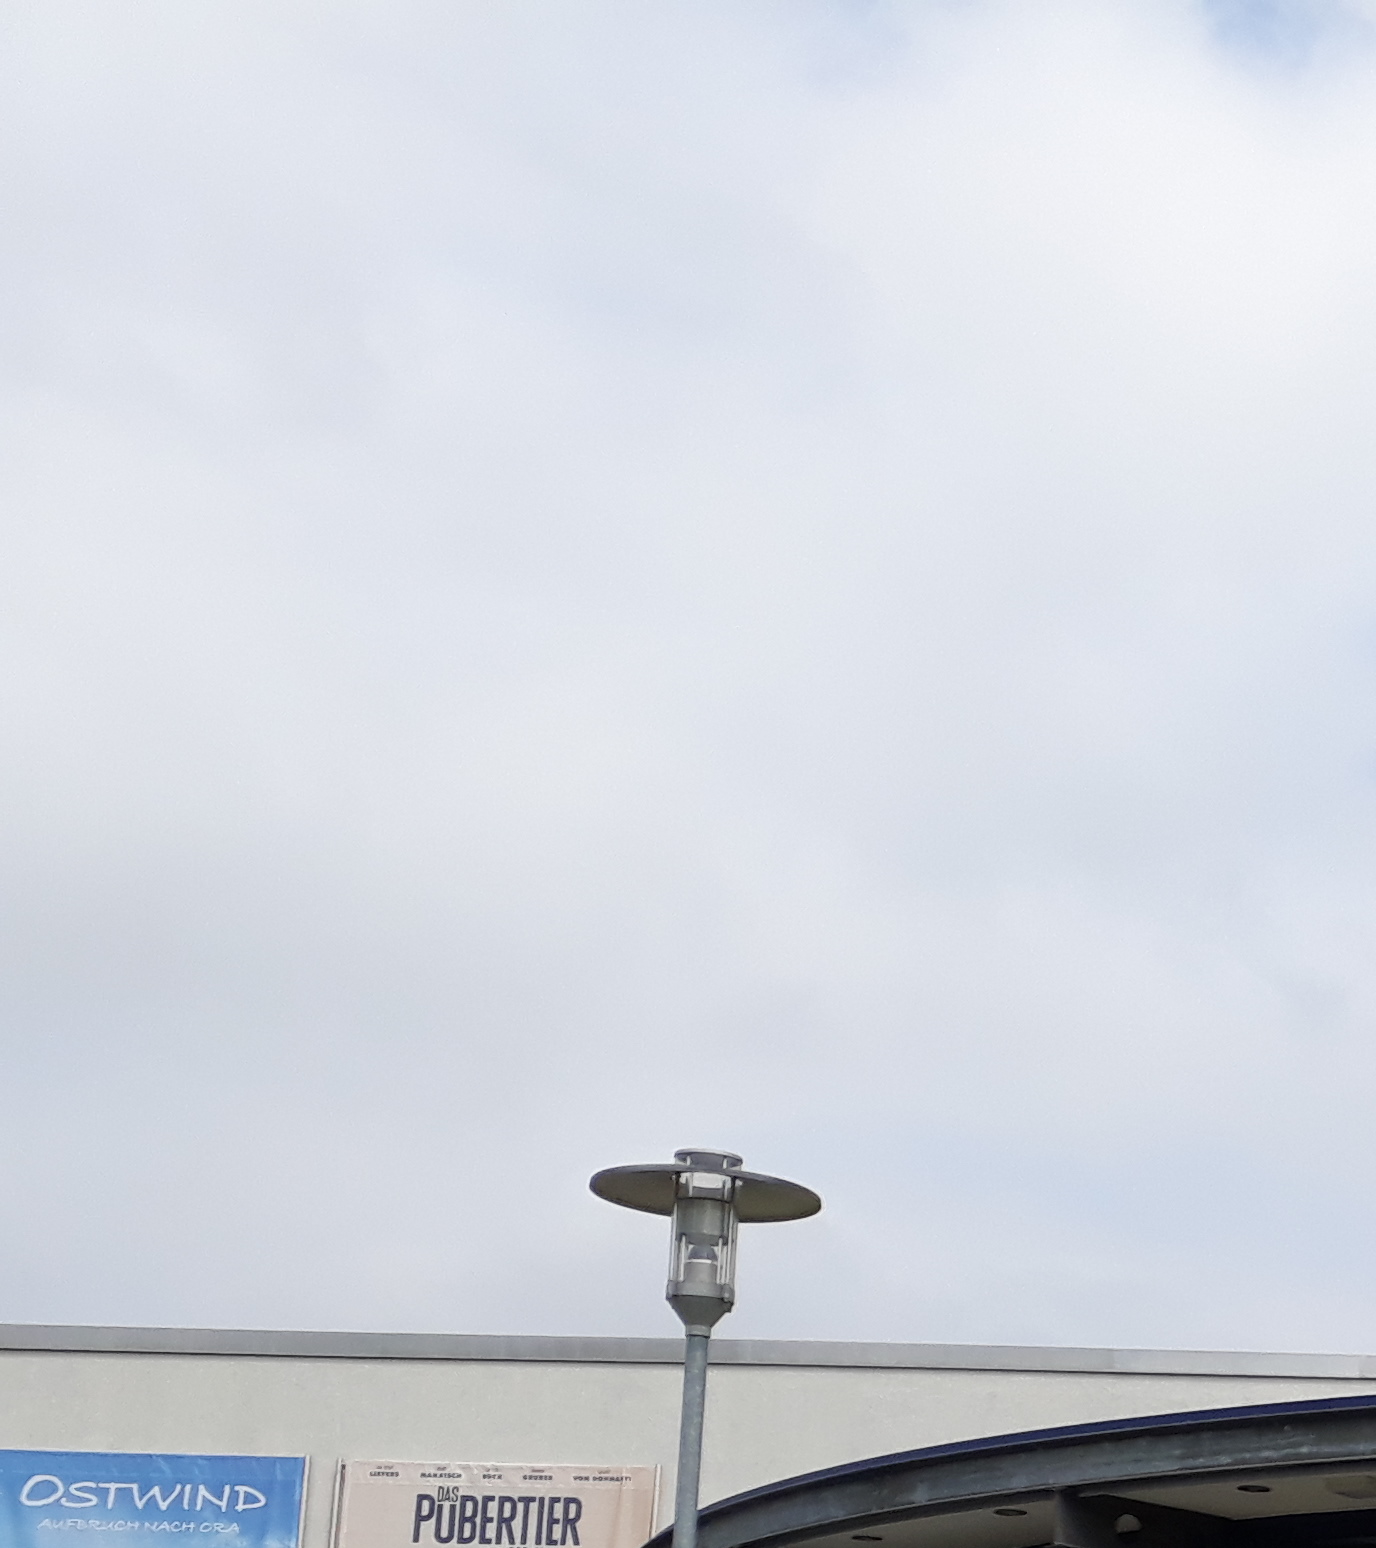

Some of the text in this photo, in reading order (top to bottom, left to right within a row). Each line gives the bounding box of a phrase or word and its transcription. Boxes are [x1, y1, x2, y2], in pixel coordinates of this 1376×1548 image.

[20, 1474, 267, 1512] OSTWIND
[437, 1485, 459, 1503] DAS
[37, 1518, 240, 1533] AUFBRUCH NACH ORA
